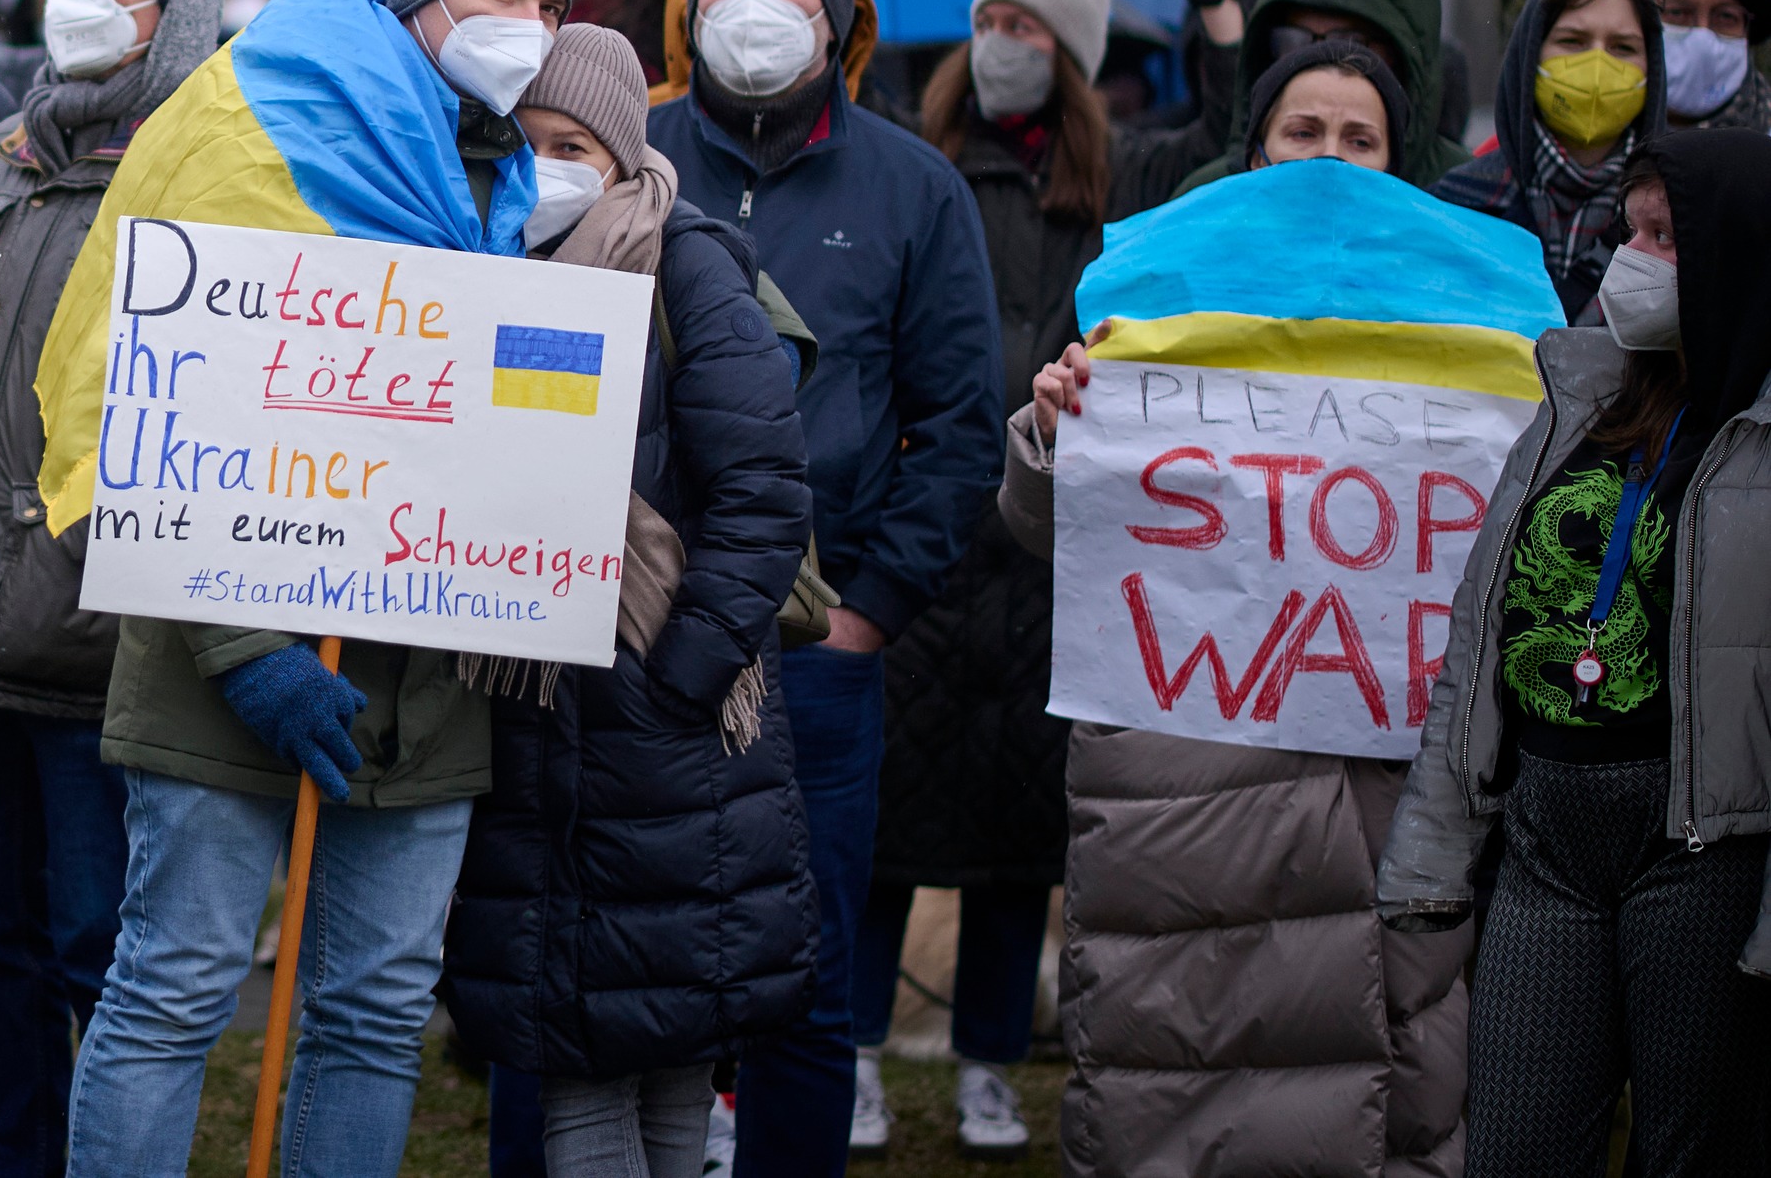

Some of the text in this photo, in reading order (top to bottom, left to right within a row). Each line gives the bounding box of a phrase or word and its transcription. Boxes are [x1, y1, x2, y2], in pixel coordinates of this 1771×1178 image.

[121, 217, 449, 340] Deutsche
[108, 314, 455, 410] ihr tötet
[1140, 370, 1472, 450] PLEASE
[98, 404, 389, 500] Ukrainer
[94, 500, 621, 597] mit eurem Schweigen
[1125, 445, 1489, 574] STOP
